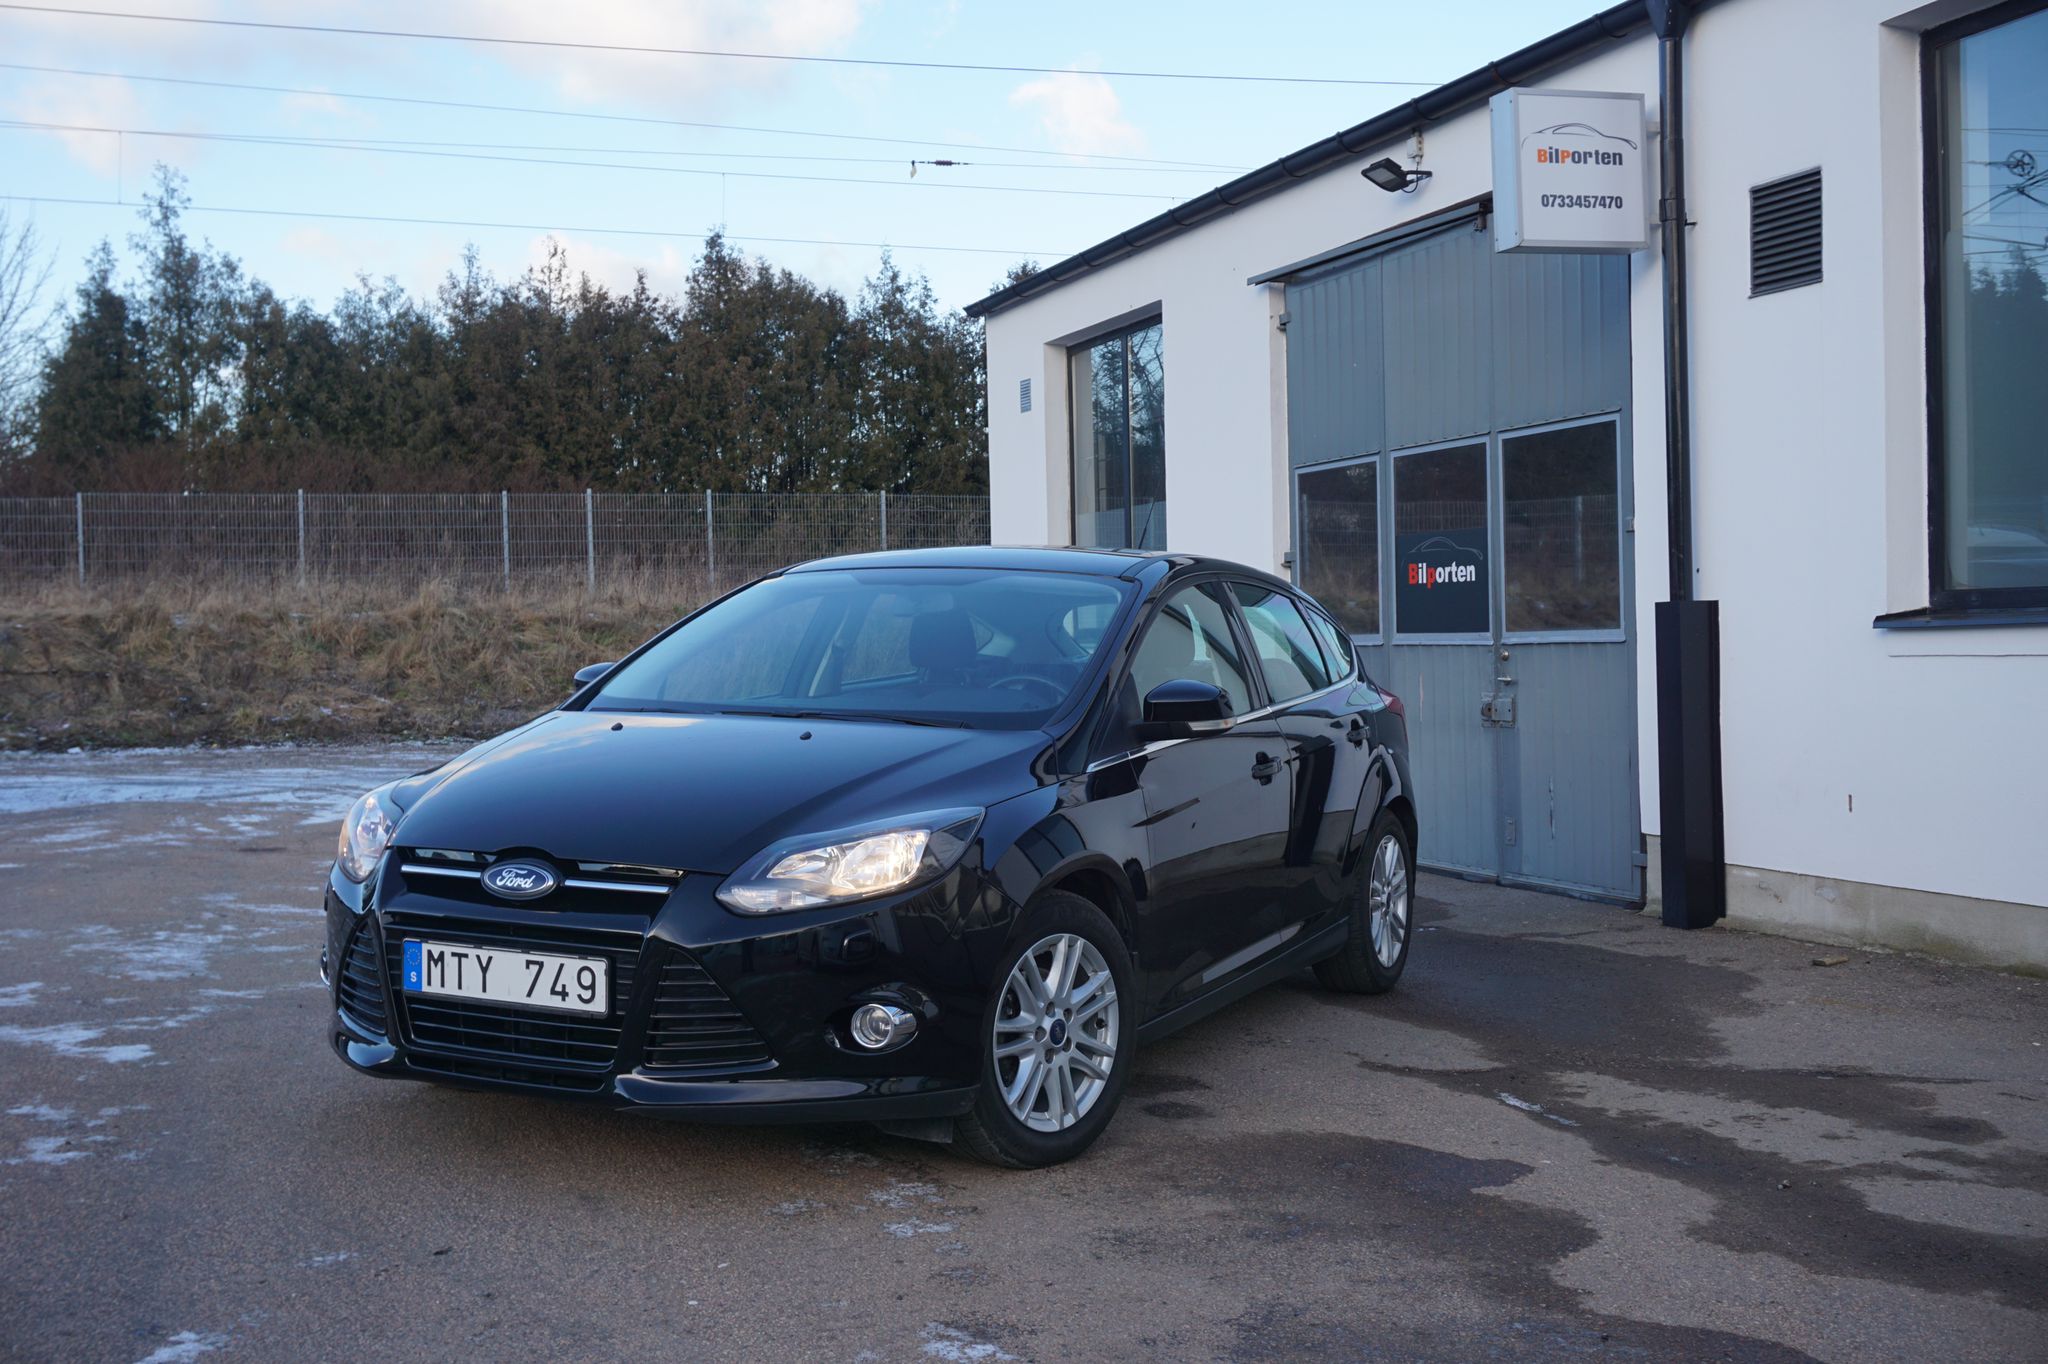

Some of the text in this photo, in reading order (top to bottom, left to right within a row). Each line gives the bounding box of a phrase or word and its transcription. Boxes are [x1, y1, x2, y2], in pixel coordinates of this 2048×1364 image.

[1537, 147, 1623, 166] BilPorten
[1541, 195, 1623, 209] 0733457470
[1408, 562, 1476, 588] Bilporten
[496, 868, 536, 889] Ford
[410, 971, 417, 982] S
[426, 949, 596, 1005] MTY 749
